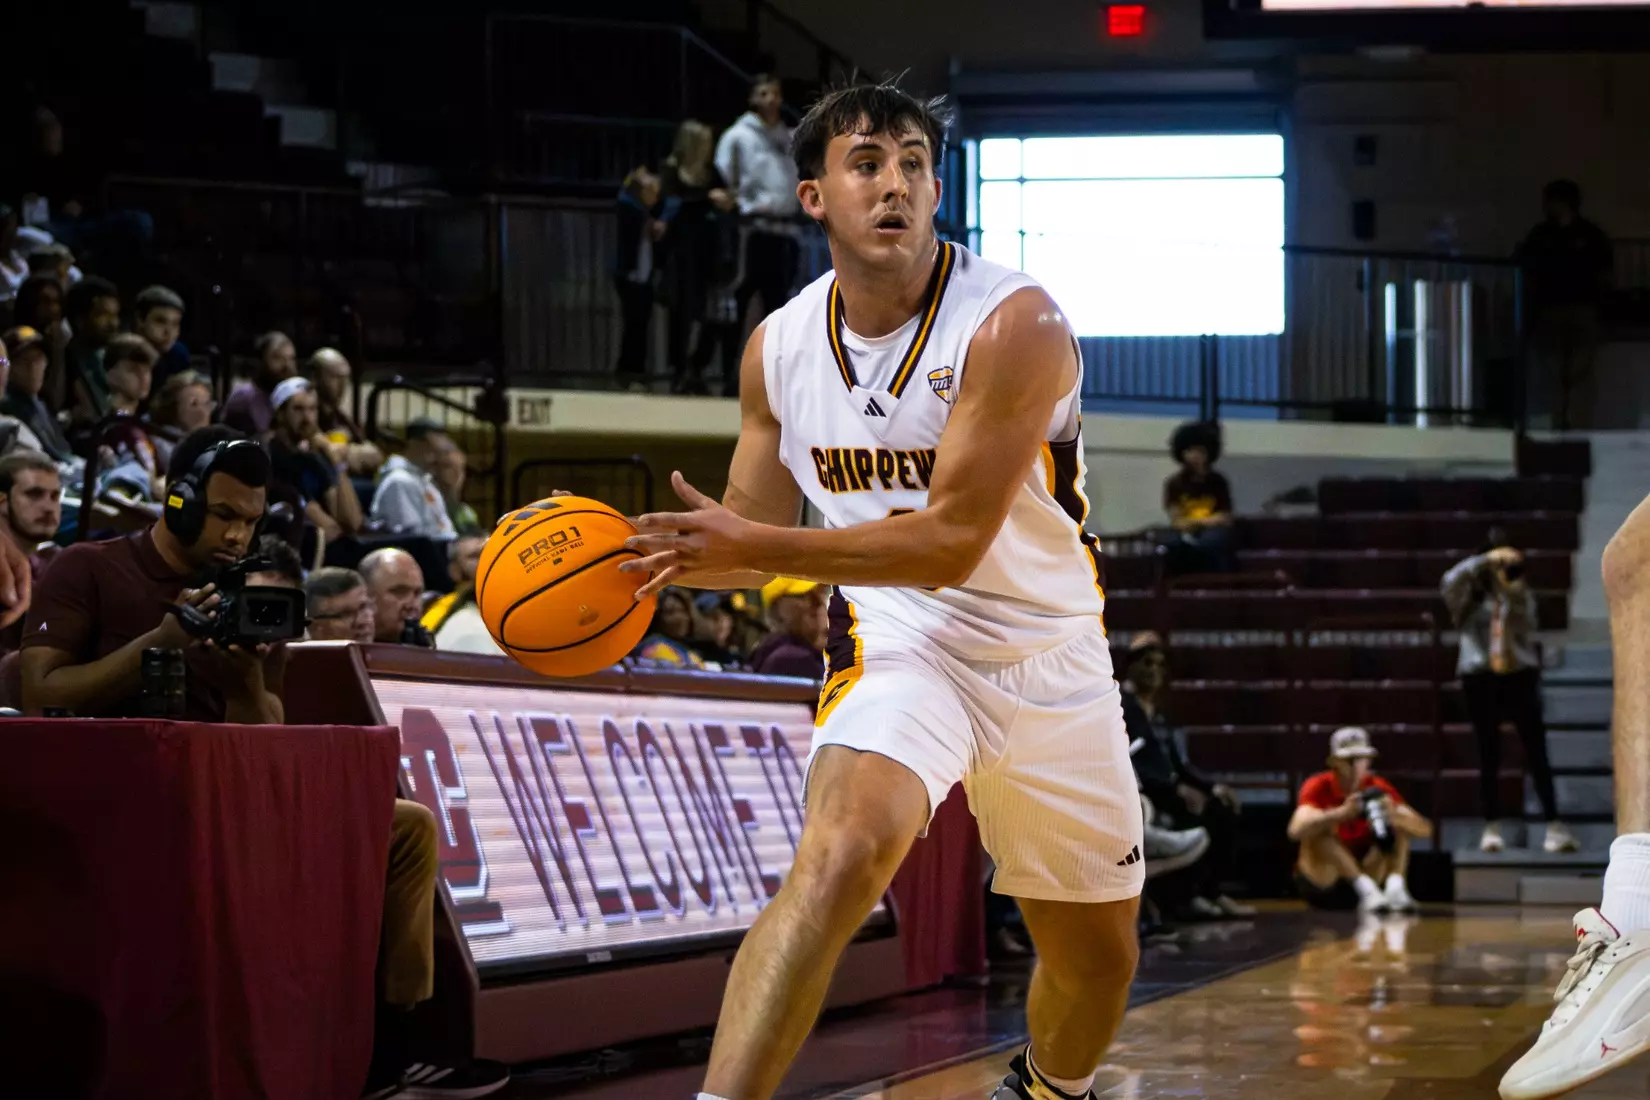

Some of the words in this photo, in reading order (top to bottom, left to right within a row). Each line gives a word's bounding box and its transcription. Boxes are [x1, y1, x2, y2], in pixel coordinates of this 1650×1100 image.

[810, 446, 937, 494] CHIPPEW
[518, 530, 568, 565] PRO
[466, 709, 784, 930] WELCOME
